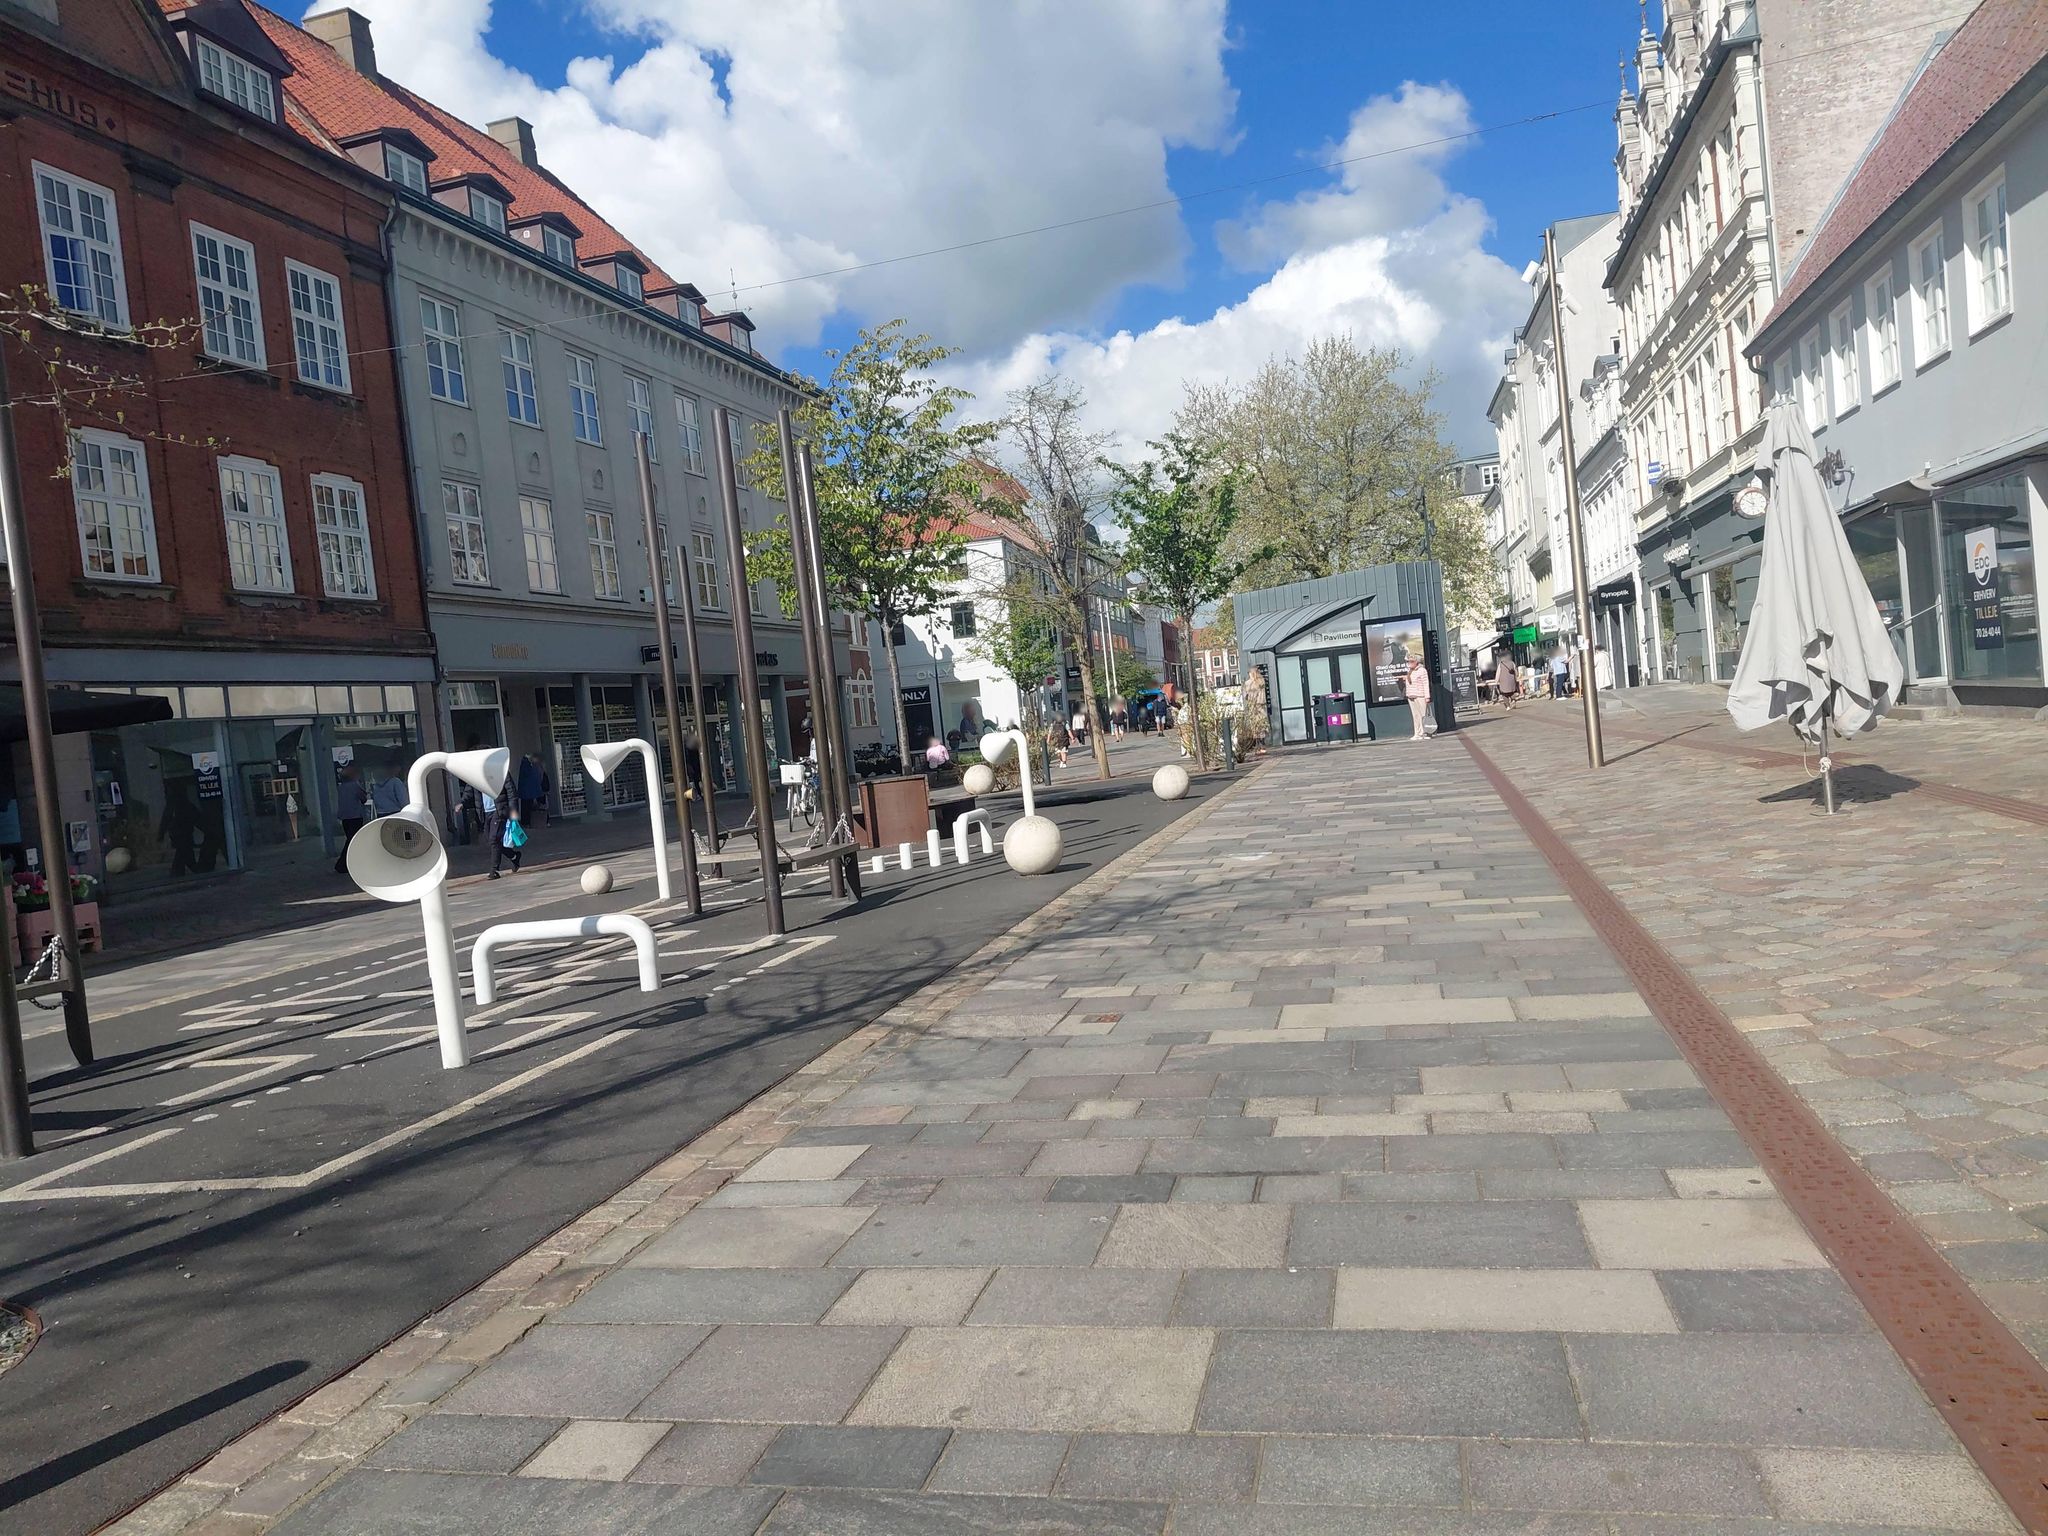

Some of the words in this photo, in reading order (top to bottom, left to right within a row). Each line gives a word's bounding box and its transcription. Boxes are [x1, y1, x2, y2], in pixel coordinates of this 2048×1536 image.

[1974, 555, 1990, 570] EDC
[1600, 589, 1630, 599] Synoptik
[1973, 588, 1996, 601] ERHVERV
[1975, 607, 1985, 620] TIL
[1985, 605, 1998, 618] LEJE
[1323, 632, 1362, 642] Pavillonen
[916, 667, 952, 681] ONLY
